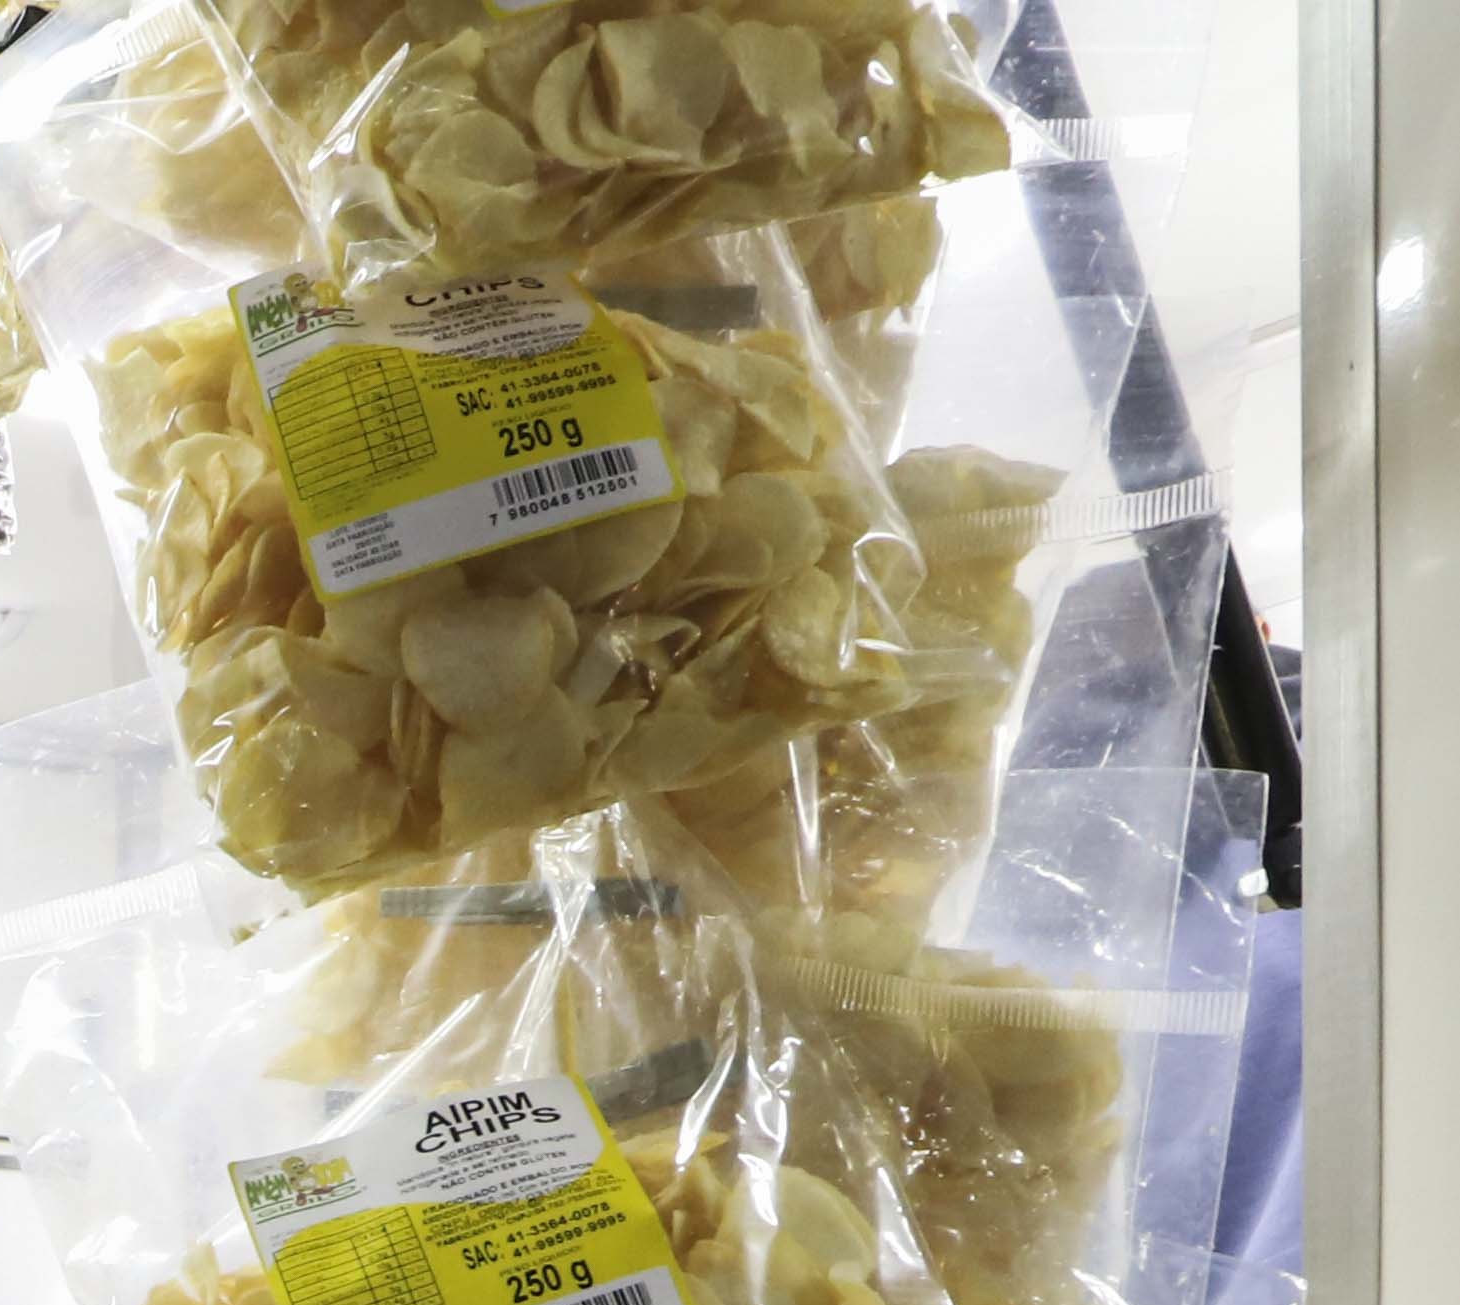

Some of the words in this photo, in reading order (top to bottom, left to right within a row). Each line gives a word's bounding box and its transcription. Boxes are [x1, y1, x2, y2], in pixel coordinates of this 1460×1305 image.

[500, 361, 602, 393] 41-3364-0078
[506, 374, 617, 409] 41-99599-9995
[499, 418, 553, 458] 250
[561, 416, 584, 447] g
[488, 512, 499, 526] 7
[507, 492, 572, 521] 980048
[576, 475, 639, 501] 512501
[415, 1106, 562, 1154] CHIPS
[425, 1091, 533, 1134] AIPIM
[422, 1182, 498, 1216] FRACIONADO
[506, 1201, 611, 1243] 41-3364-0078
[513, 1211, 627, 1258] 41-99599-9995
[506, 1263, 562, 1304] 250
[570, 1259, 594, 1289] g
